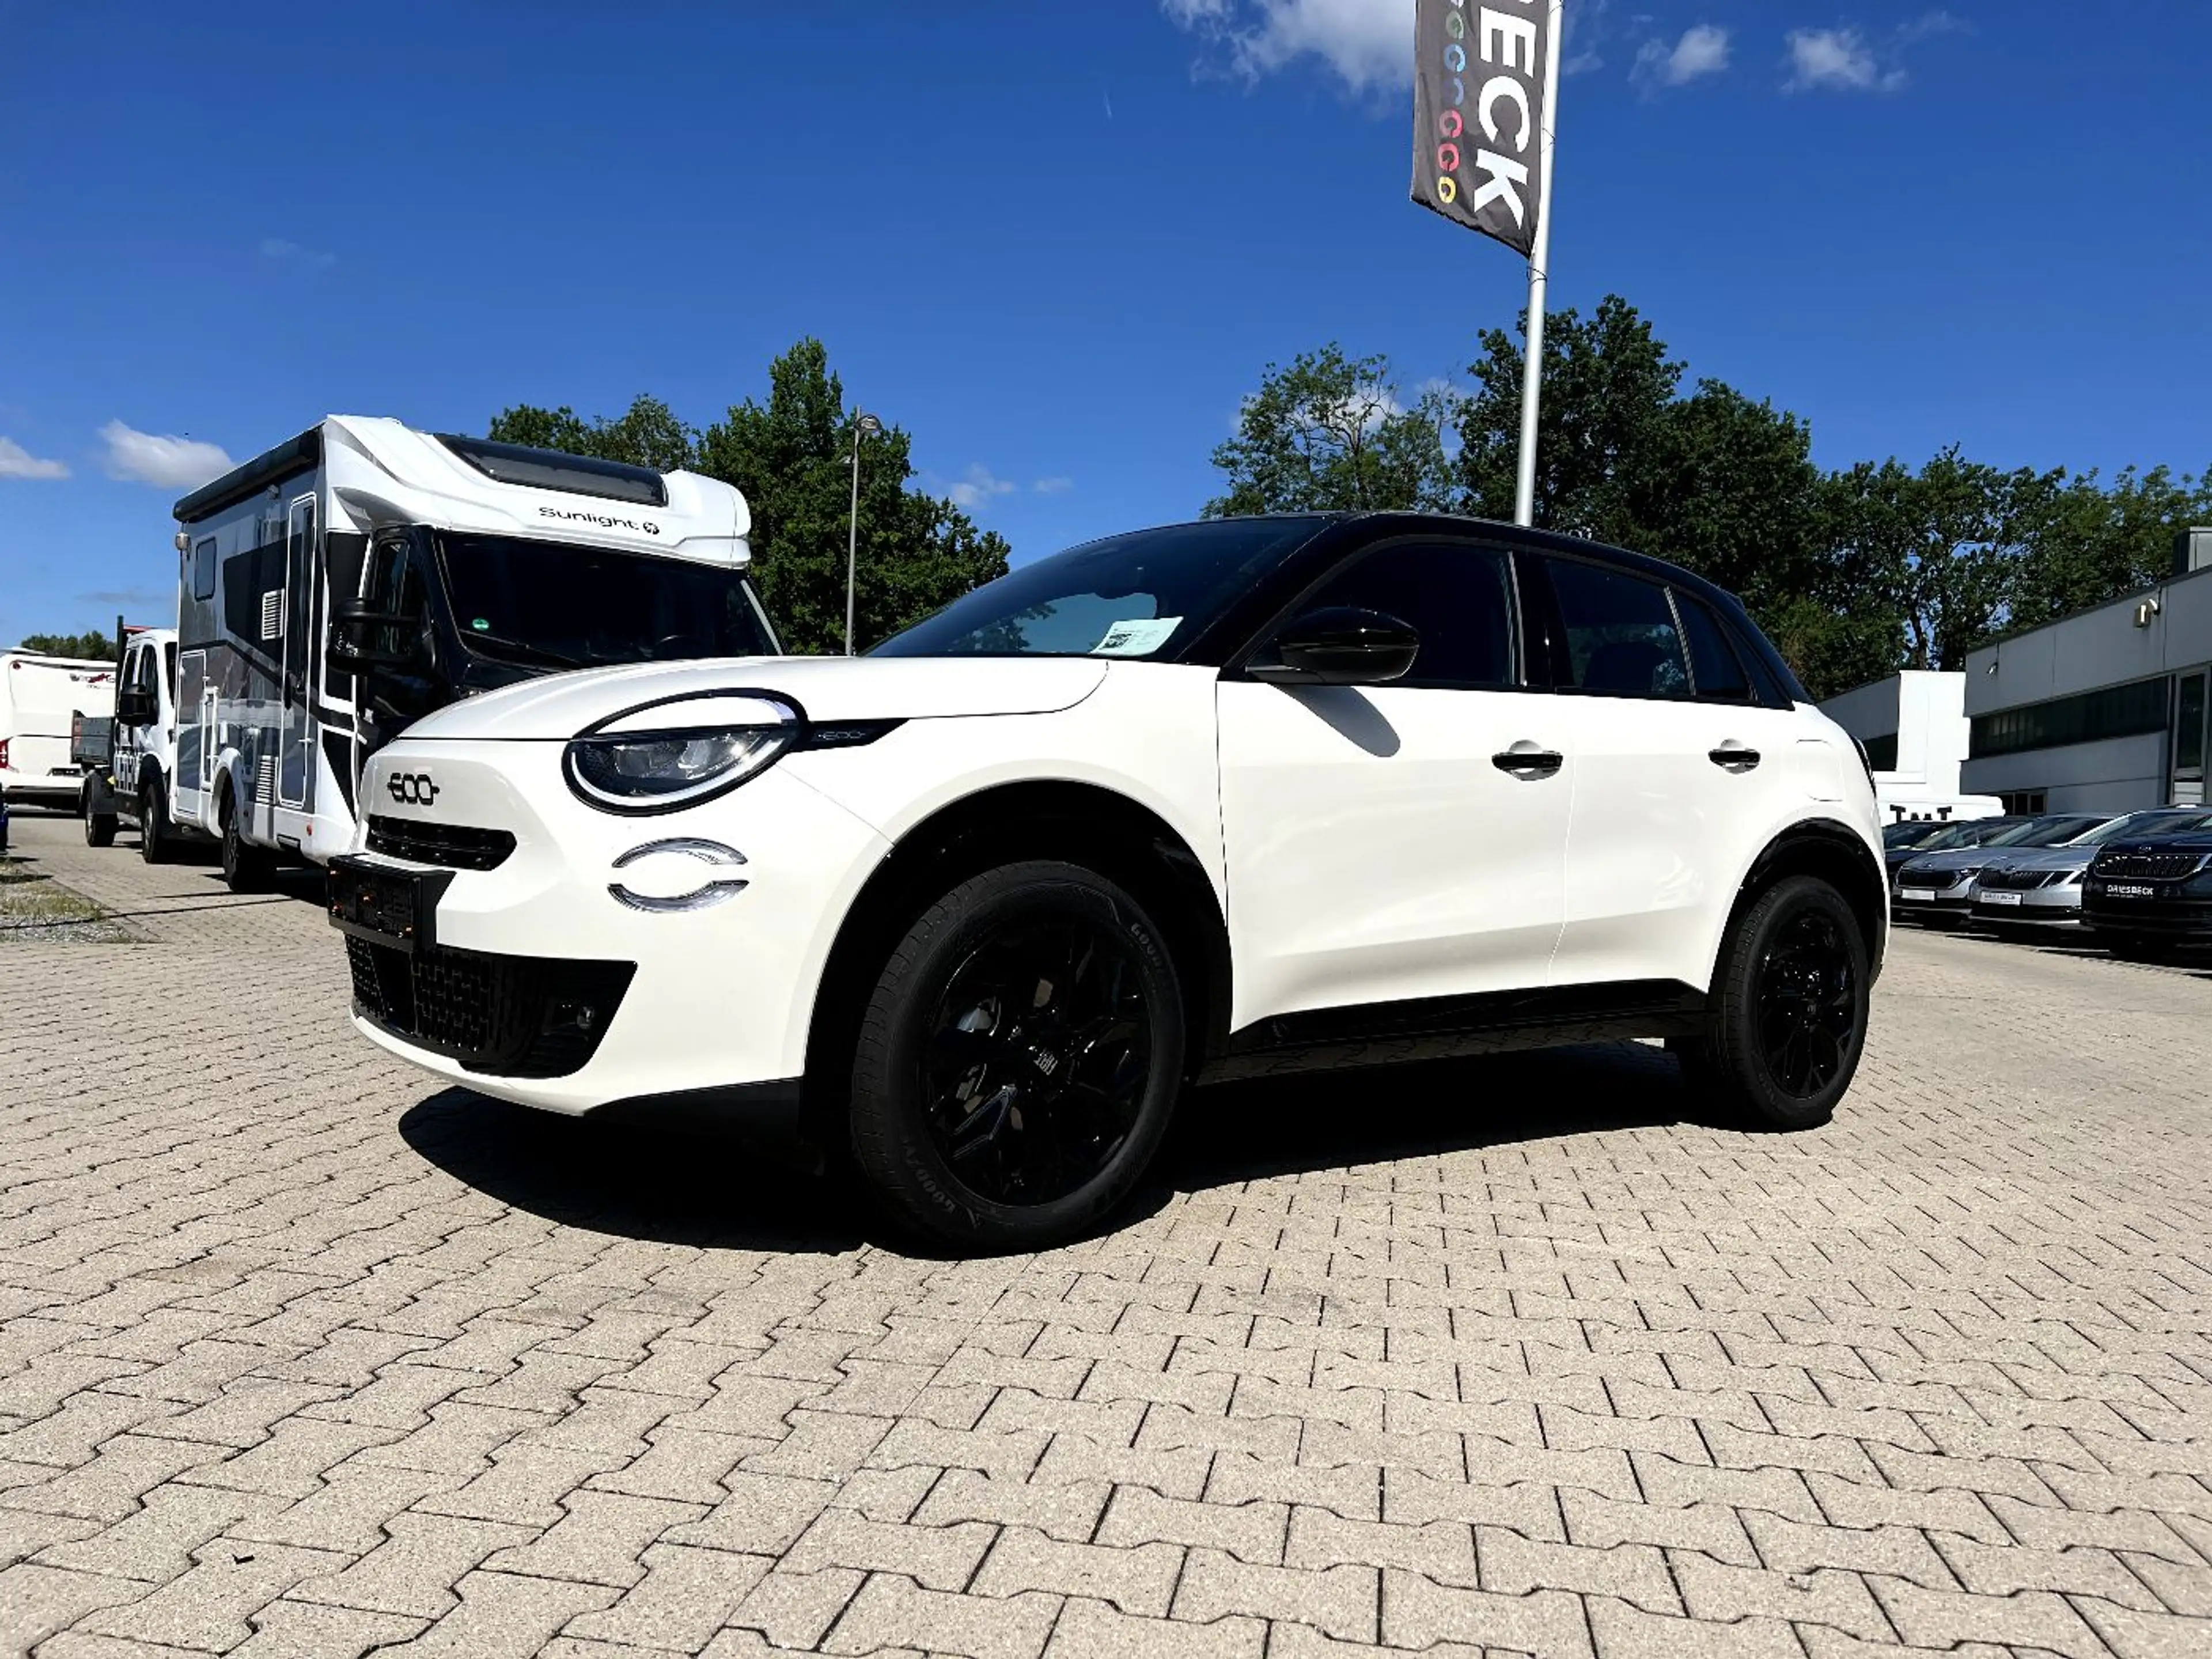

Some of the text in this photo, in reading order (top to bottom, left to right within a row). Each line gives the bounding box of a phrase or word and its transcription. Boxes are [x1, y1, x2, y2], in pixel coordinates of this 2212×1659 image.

[1474, 0, 1537, 229] ECK
[539, 507, 639, 530] Sunlight
[388, 772, 438, 806] 600
